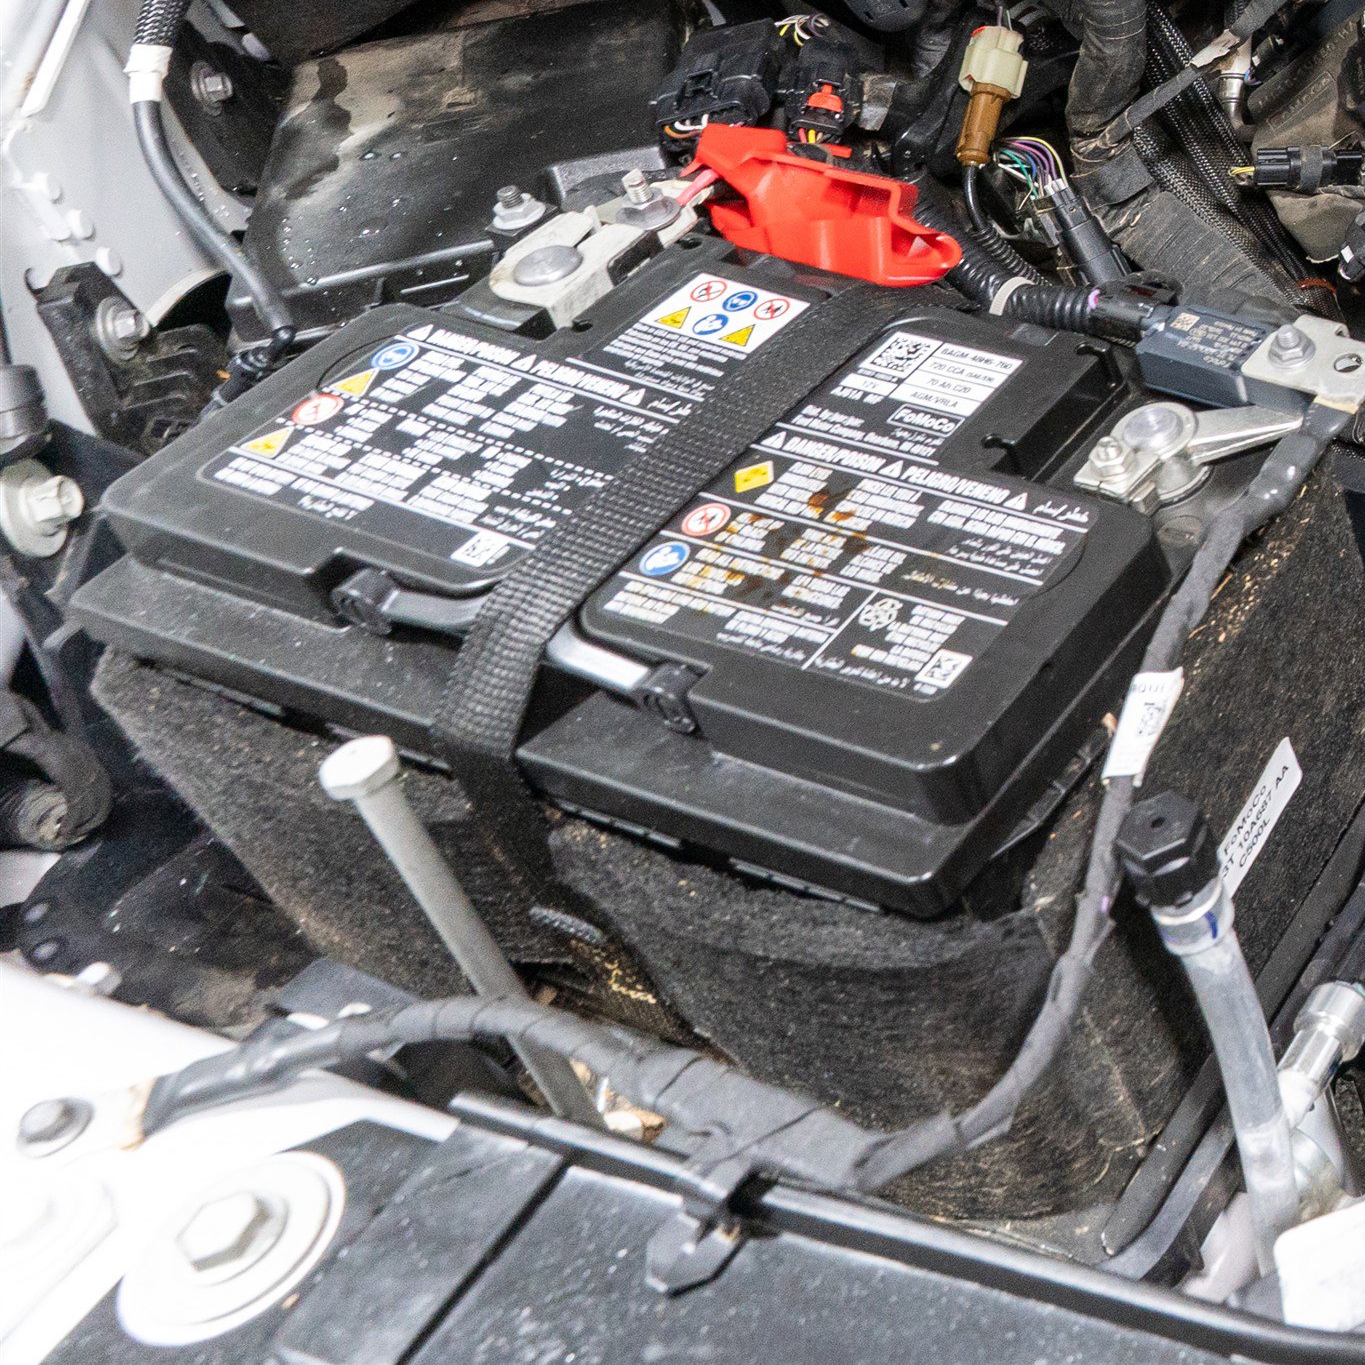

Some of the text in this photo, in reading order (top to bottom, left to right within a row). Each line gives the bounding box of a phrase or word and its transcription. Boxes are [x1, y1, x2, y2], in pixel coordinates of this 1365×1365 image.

[928, 377, 939, 386] 70
[947, 364, 965, 376] CCA
[894, 408, 957, 434] FoMoCo
[782, 436, 887, 473] DANGER/POISON
[1274, 764, 1290, 788] AA
[1223, 785, 1267, 855] FoMoCo
[1239, 817, 1271, 868] C500L
